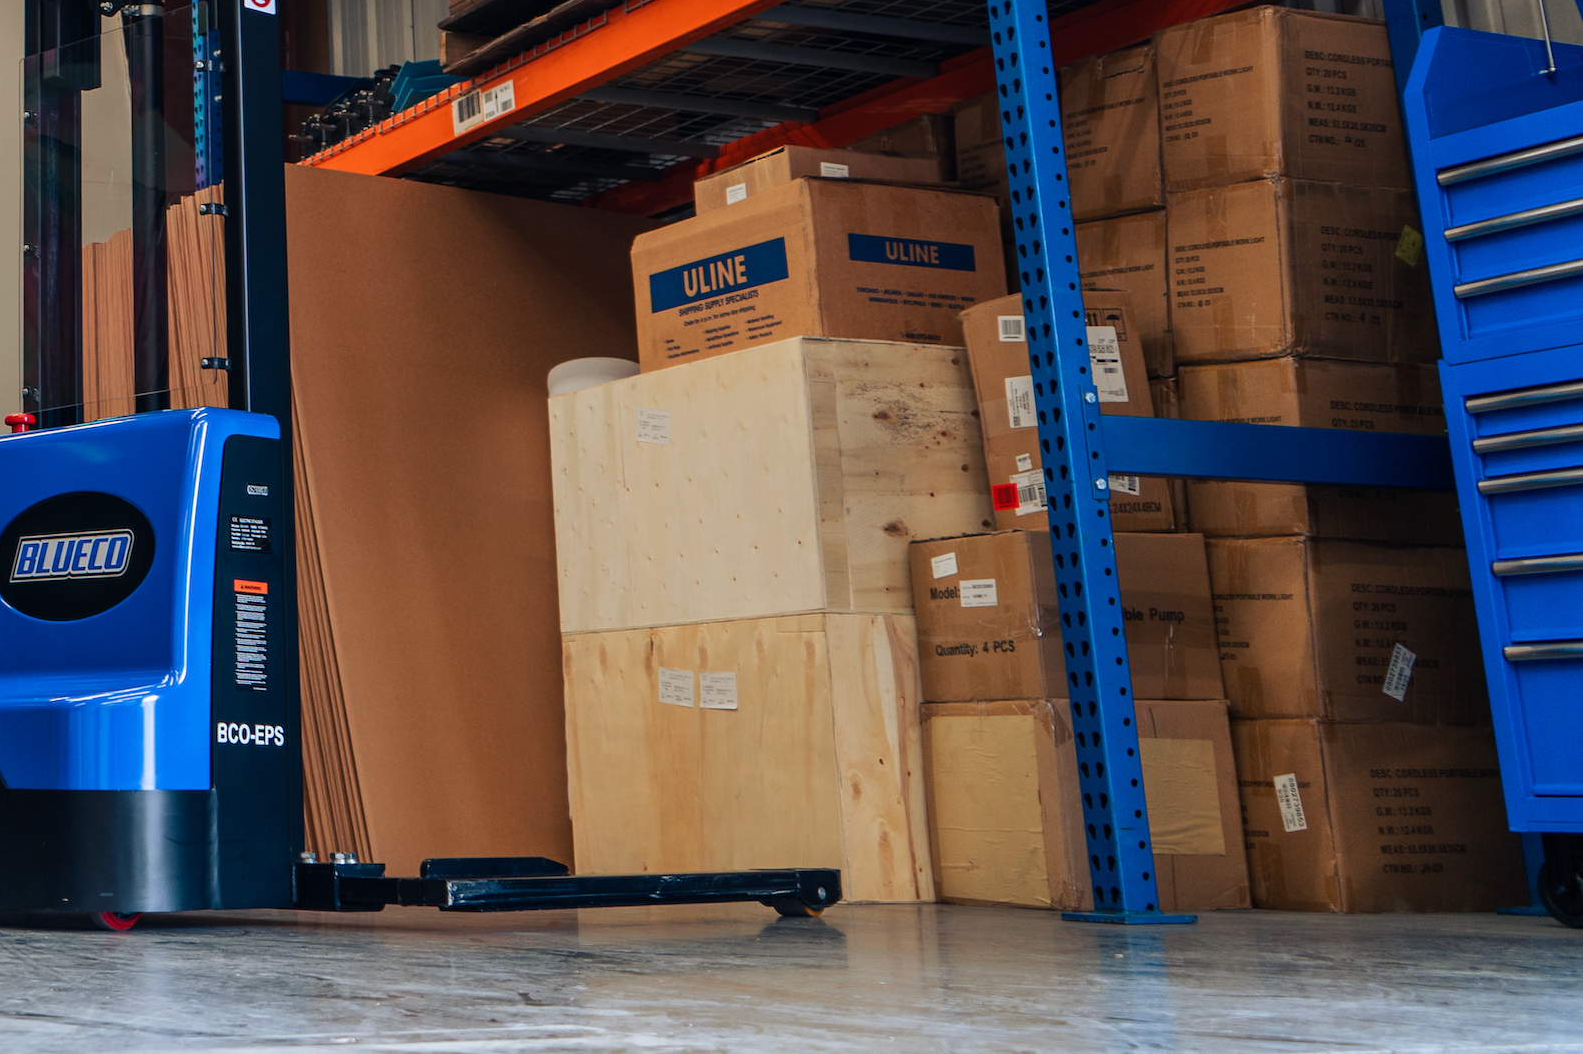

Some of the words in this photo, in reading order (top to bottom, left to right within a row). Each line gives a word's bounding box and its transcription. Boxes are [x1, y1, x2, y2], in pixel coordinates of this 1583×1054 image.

[1328, 53, 1365, 65] CORDLESS
[1333, 70, 1347, 79] PCS
[1341, 87, 1356, 97] KGS
[1342, 104, 1357, 113] KGS
[885, 241, 940, 264] ULINE
[683, 255, 748, 297] ULINE
[679, 303, 704, 317] SHIPPING
[705, 299, 724, 312] SUPPLY
[725, 289, 759, 305] SPECIALISTS
[718, 312, 731, 320] same
[731, 309, 739, 317] day
[739, 305, 756, 316] shipping
[1331, 400, 1352, 411] DESC:
[1354, 402, 1393, 414] CORDLESS
[1251, 416, 1267, 424] WORK
[1267, 415, 1282, 424] LIGHT
[1332, 418, 1349, 428] QTY:
[1359, 420, 1375, 430] PCS
[13, 533, 132, 579] BLUECO
[930, 586, 960, 600] Model:
[1149, 607, 1185, 624] Pump
[936, 643, 978, 657] Quantity:
[982, 642, 989, 653] 4
[993, 640, 1015, 652] PCS
[217, 722, 285, 747] BCO-EPS
